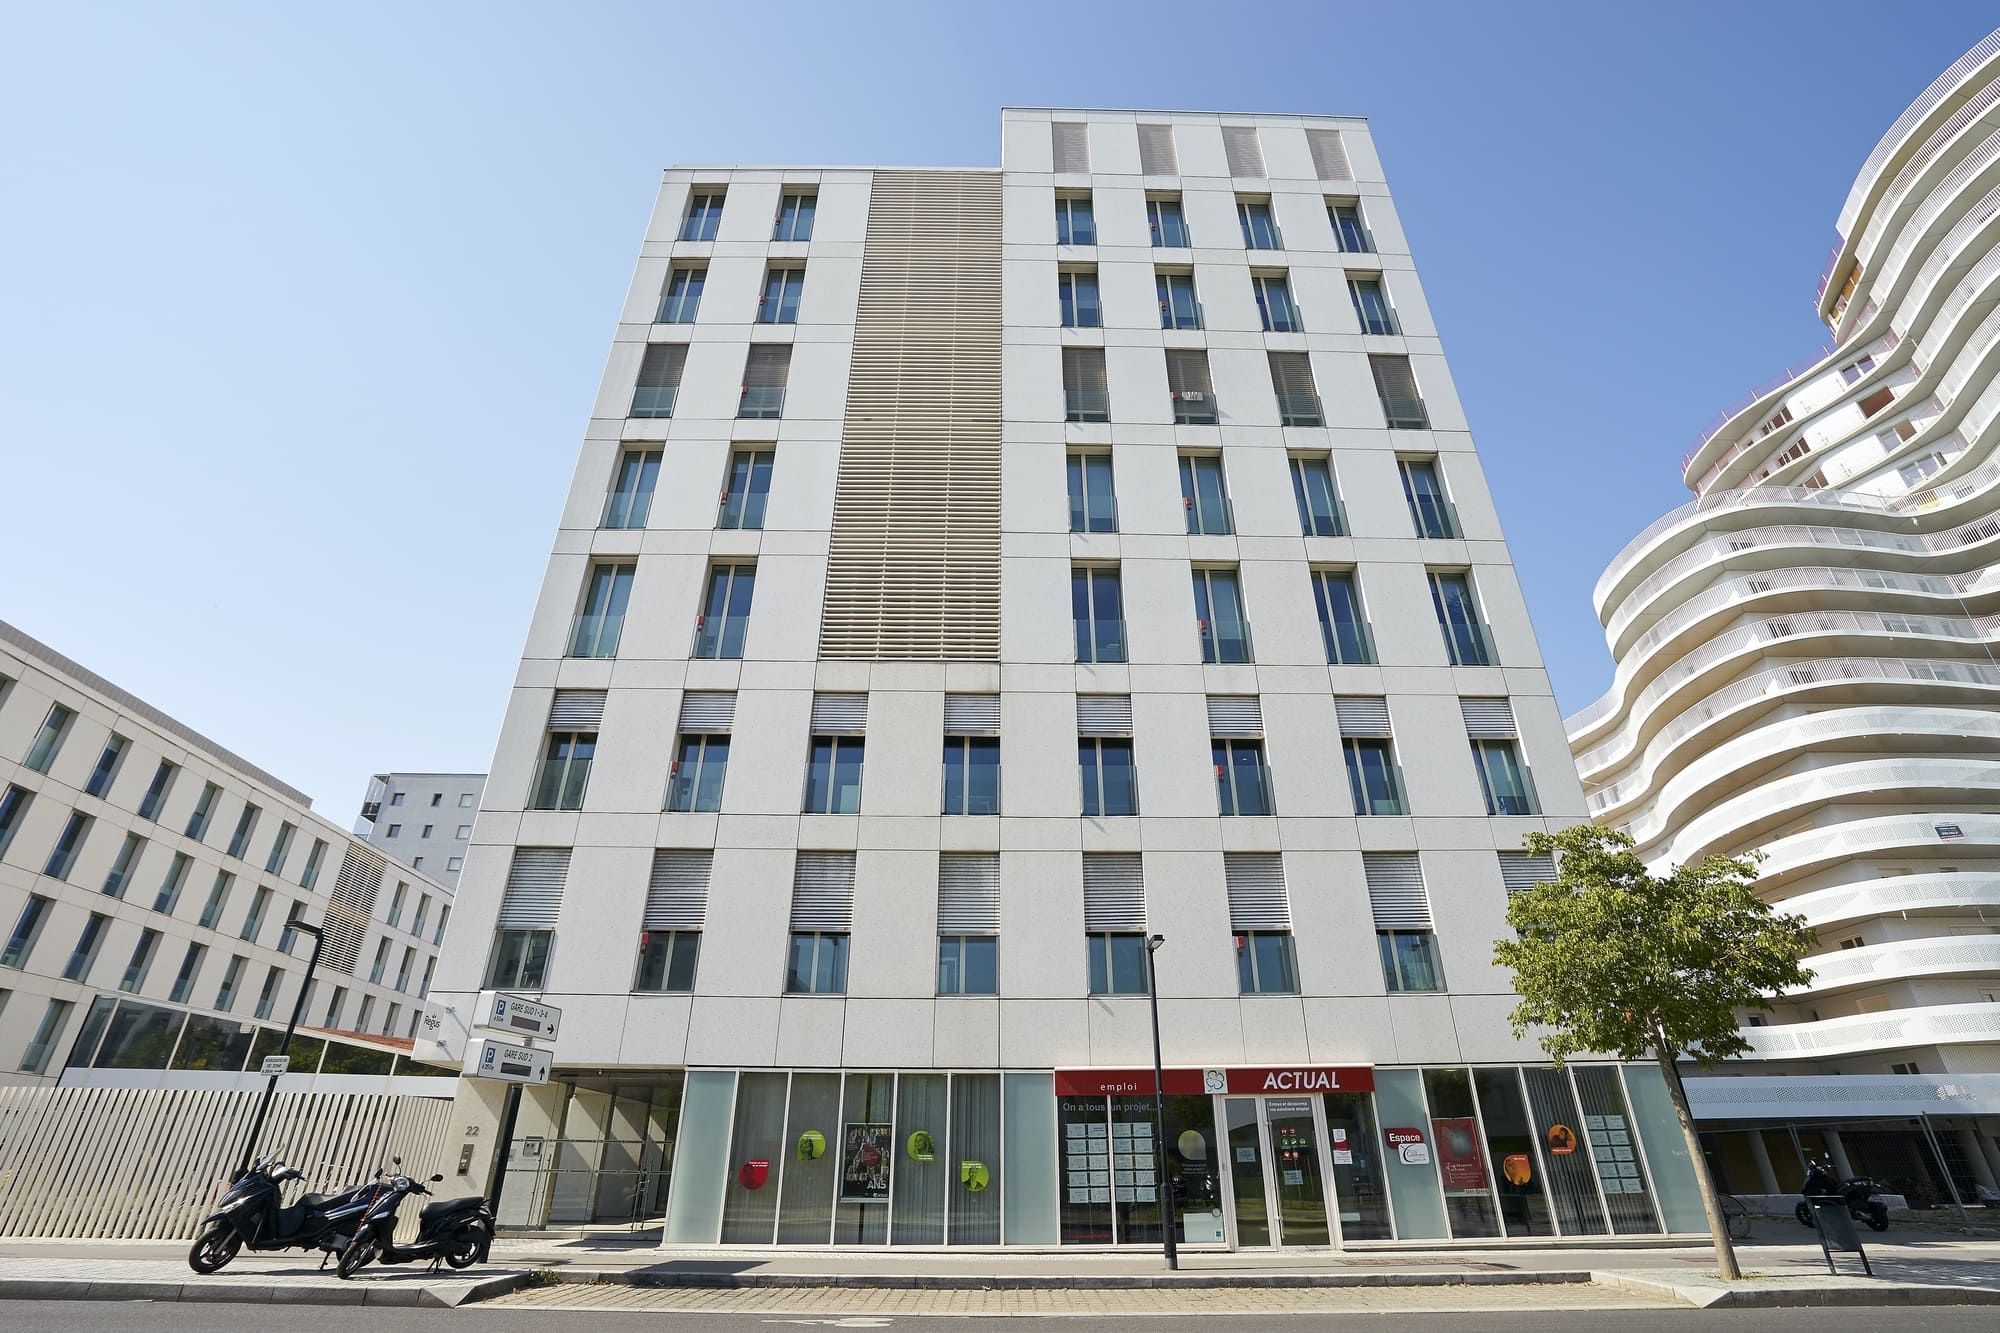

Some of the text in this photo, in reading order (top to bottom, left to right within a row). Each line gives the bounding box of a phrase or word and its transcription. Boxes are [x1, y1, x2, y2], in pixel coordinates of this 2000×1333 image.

[510, 1002, 524, 1013] GARE
[524, 1006, 535, 1016] SUD
[424, 1015, 441, 1030] Regus
[504, 1049, 533, 1062] GARE SUD 2
[1263, 1071, 1340, 1090] ACTUAL
[1100, 1082, 1137, 1093] emploi
[1063, 1102, 1076, 1112] On
[1086, 1103, 1106, 1111] tous
[465, 1125, 480, 1136] 22
[1389, 1133, 1421, 1143] Espace
[866, 1180, 887, 1190] ANS
